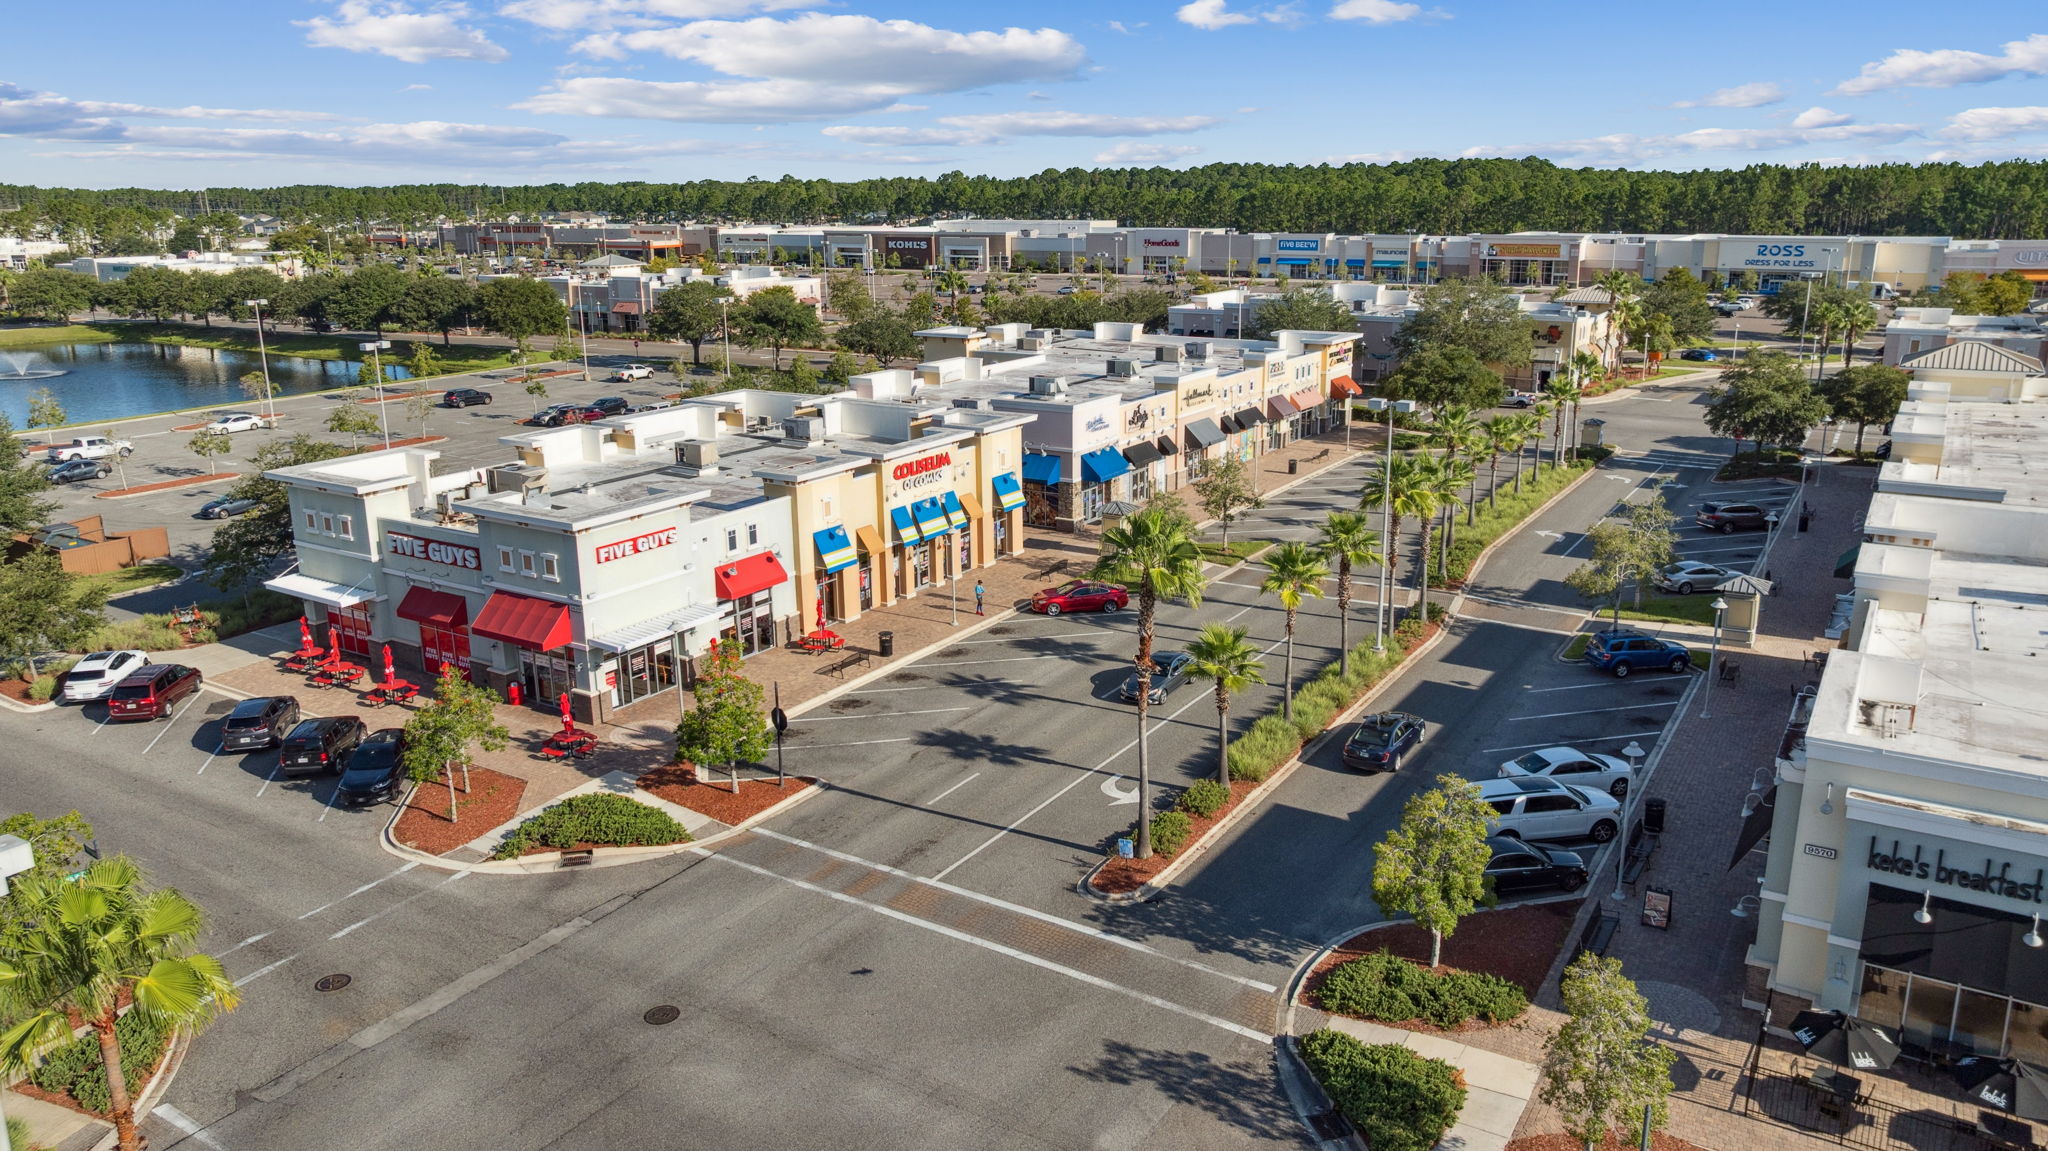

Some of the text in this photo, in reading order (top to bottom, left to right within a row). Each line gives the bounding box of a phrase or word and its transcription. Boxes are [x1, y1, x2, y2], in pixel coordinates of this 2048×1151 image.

[888, 241, 928, 249] KOHL'S
[1757, 244, 1805, 257] ROSS
[1744, 259, 1771, 267] DRESS
[1183, 383, 1214, 407] Hallmark
[893, 451, 951, 480] COLISEUM
[913, 469, 943, 488] COMICS
[387, 533, 479, 569] FIVE GUYS
[598, 529, 678, 563] FIVE GUYS
[1806, 846, 1833, 857] 9570
[1867, 835, 2043, 904] keke's breakfast
